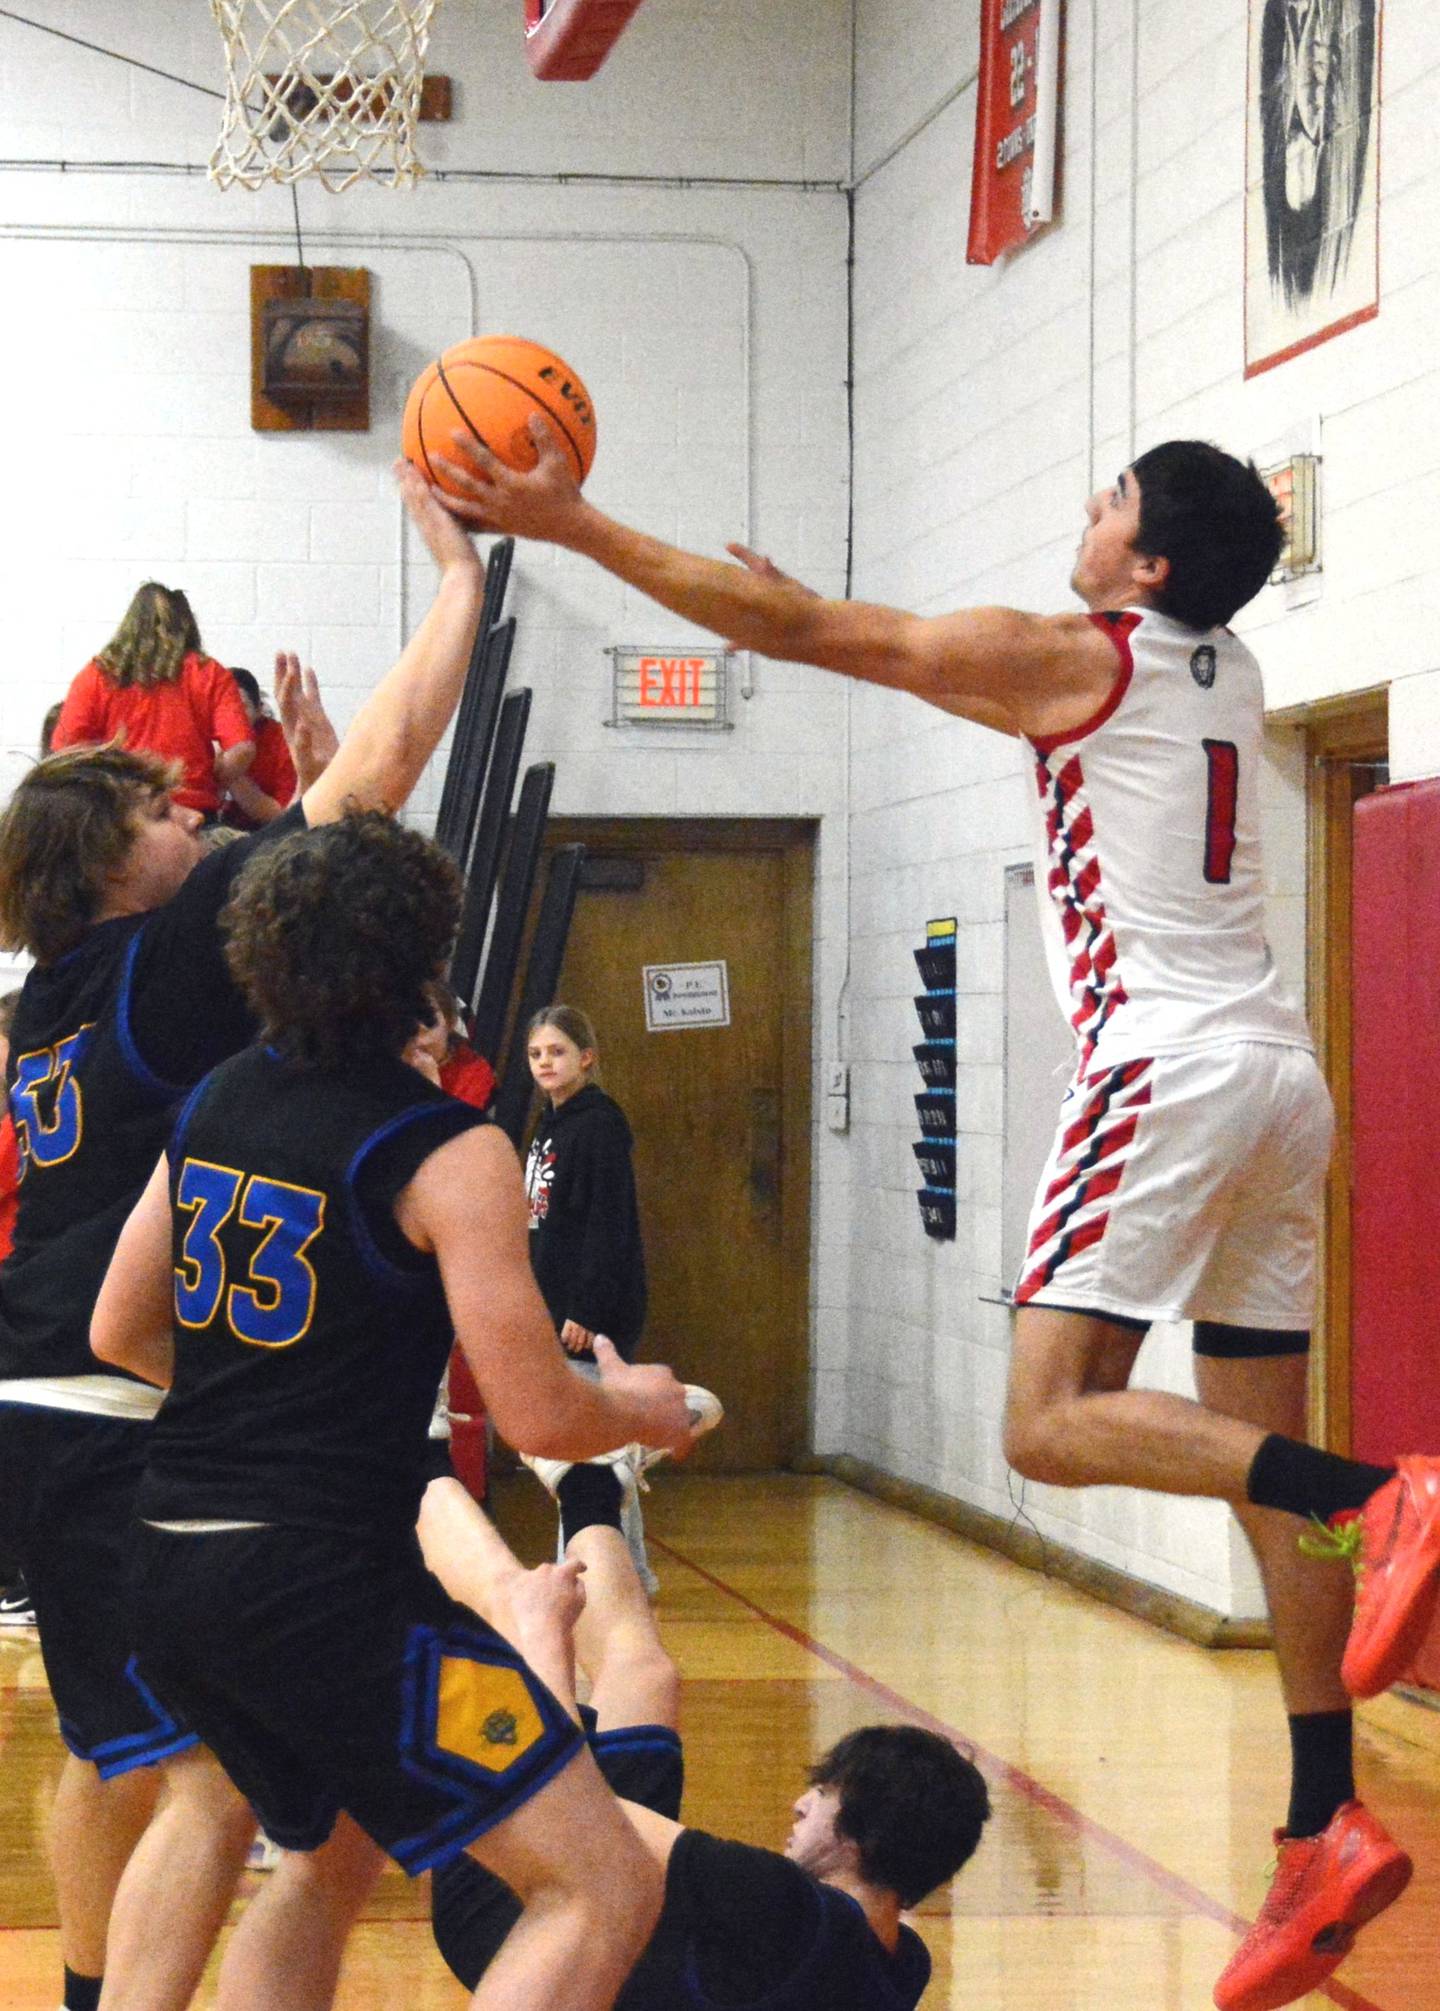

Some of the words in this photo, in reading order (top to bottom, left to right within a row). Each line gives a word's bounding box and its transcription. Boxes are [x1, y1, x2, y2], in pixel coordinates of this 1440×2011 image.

[641, 658, 704, 706] EXIT
[1201, 738, 1238, 884] 1
[173, 1157, 327, 1349] 33
